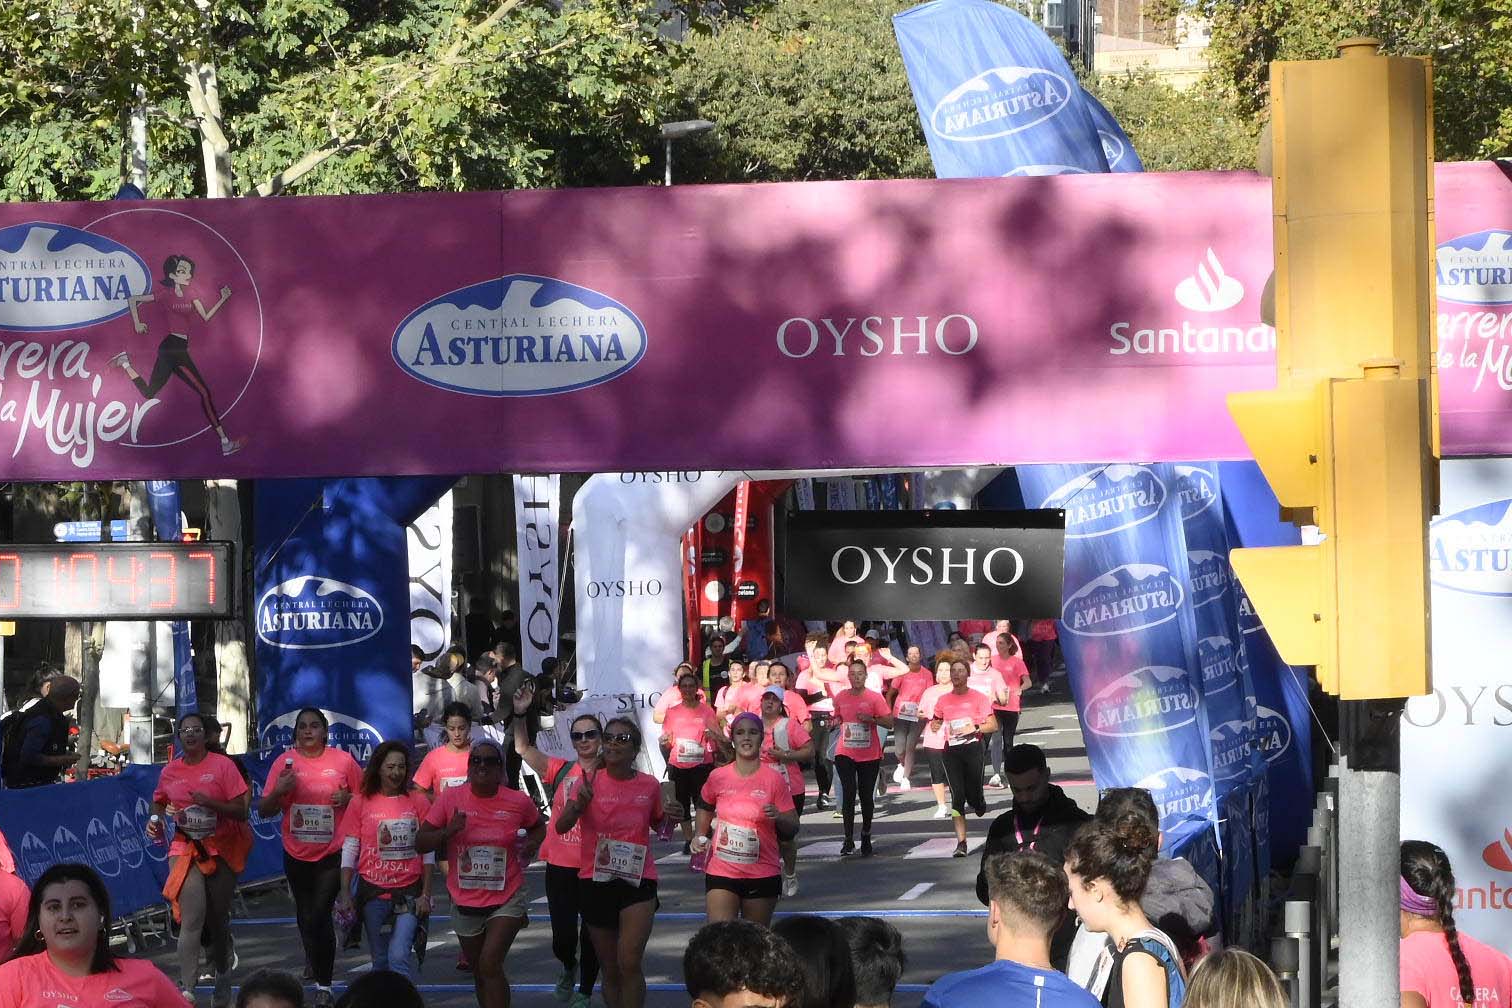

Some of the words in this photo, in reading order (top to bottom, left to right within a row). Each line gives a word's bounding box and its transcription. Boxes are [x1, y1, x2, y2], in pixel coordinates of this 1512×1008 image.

[54, 259, 126, 270] LECHERA
[451, 318, 528, 330] CENTRAL
[538, 316, 617, 328] LECHERA
[777, 314, 979, 358] OYSHO
[1110, 321, 1277, 354] Santand
[412, 322, 626, 366] ASTURIANA
[1461, 341, 1478, 369] la
[13, 374, 161, 468] Mujer
[831, 545, 1024, 586] OYSHO
[587, 578, 663, 599] OYSHO
[262, 605, 375, 634] ASTURIANA
[1449, 986, 1499, 1001] CAERA
